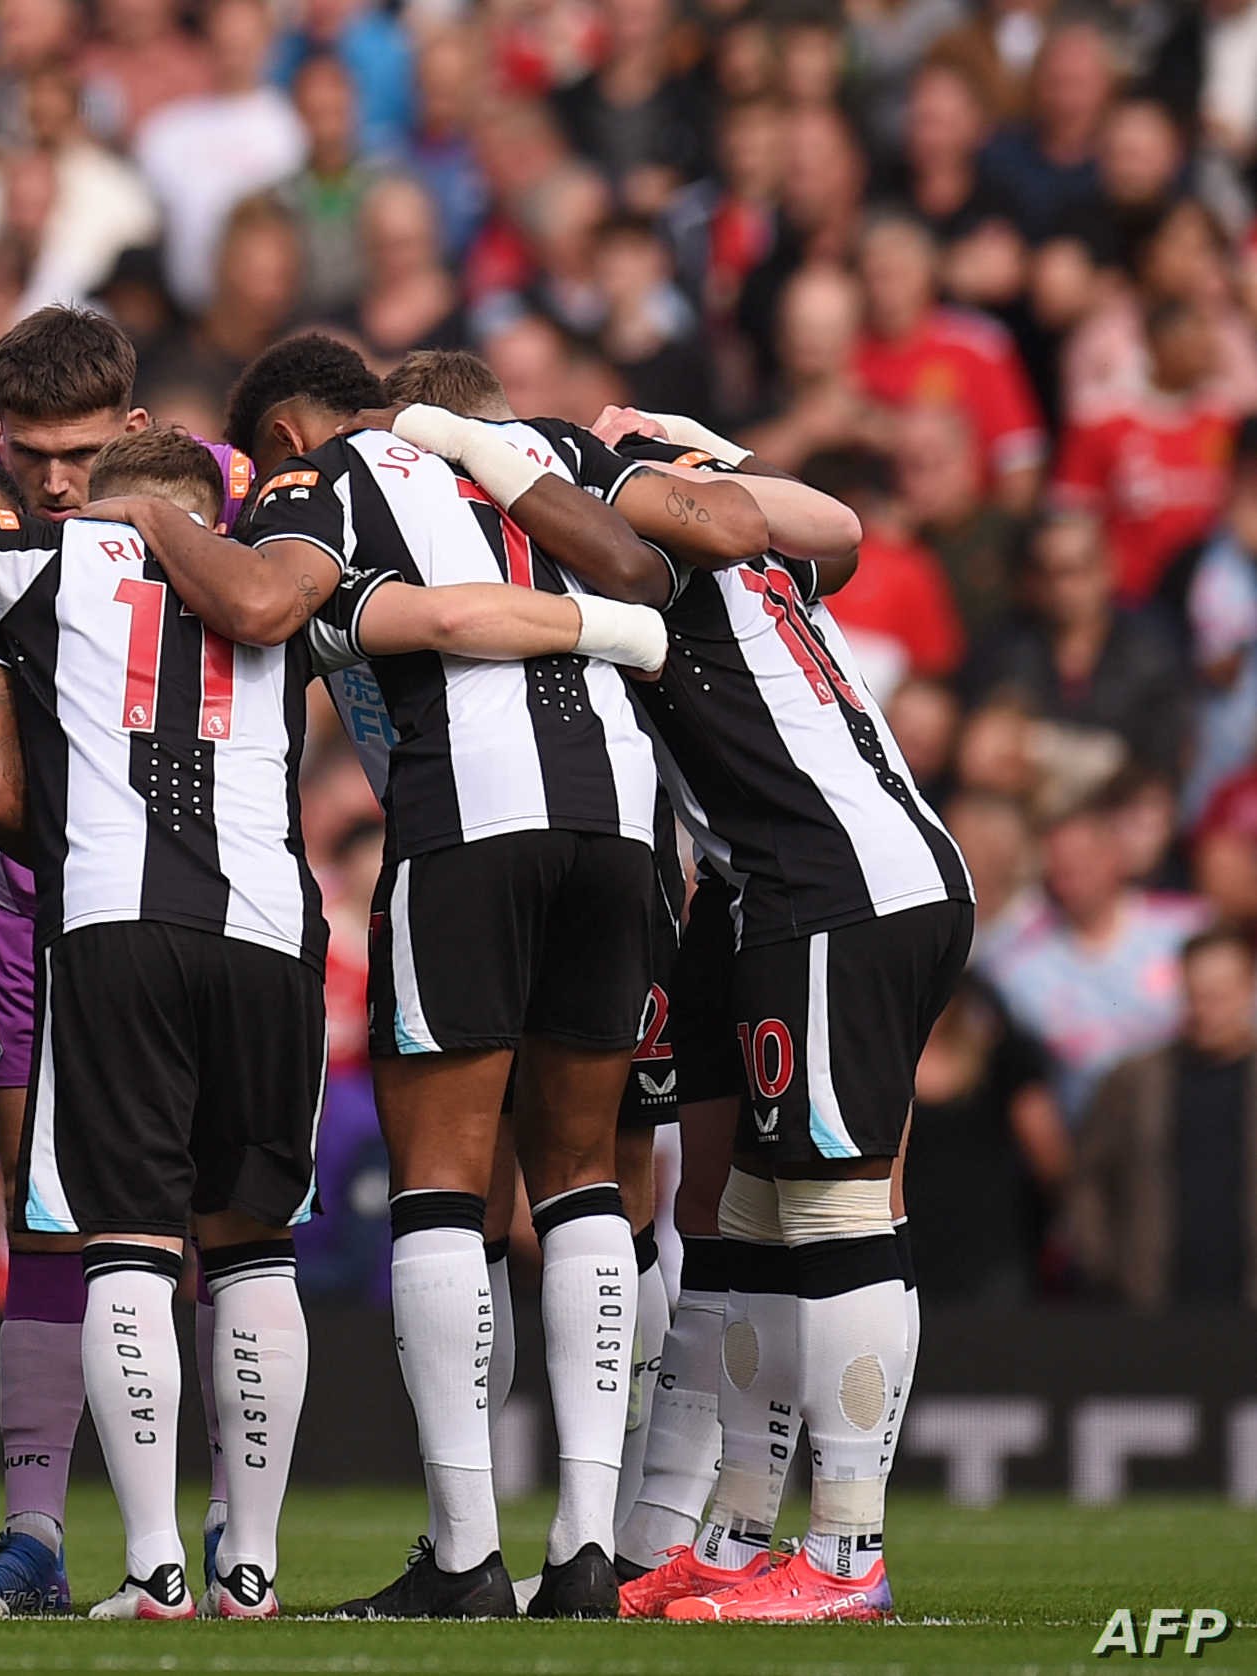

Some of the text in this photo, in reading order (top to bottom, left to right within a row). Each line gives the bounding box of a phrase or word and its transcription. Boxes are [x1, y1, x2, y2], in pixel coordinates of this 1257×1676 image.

[112, 577, 235, 741] 11
[632, 981, 674, 1062] 2
[737, 1017, 794, 1099] 10
[112, 1303, 157, 1445] CASTORE
[474, 1287, 493, 1410] CASTORE
[595, 1267, 623, 1392] CASTORE
[232, 1327, 268, 1469] CASTORE
[879, 1385, 902, 1467] TORE
[6, 1454, 51, 1470] UFC
